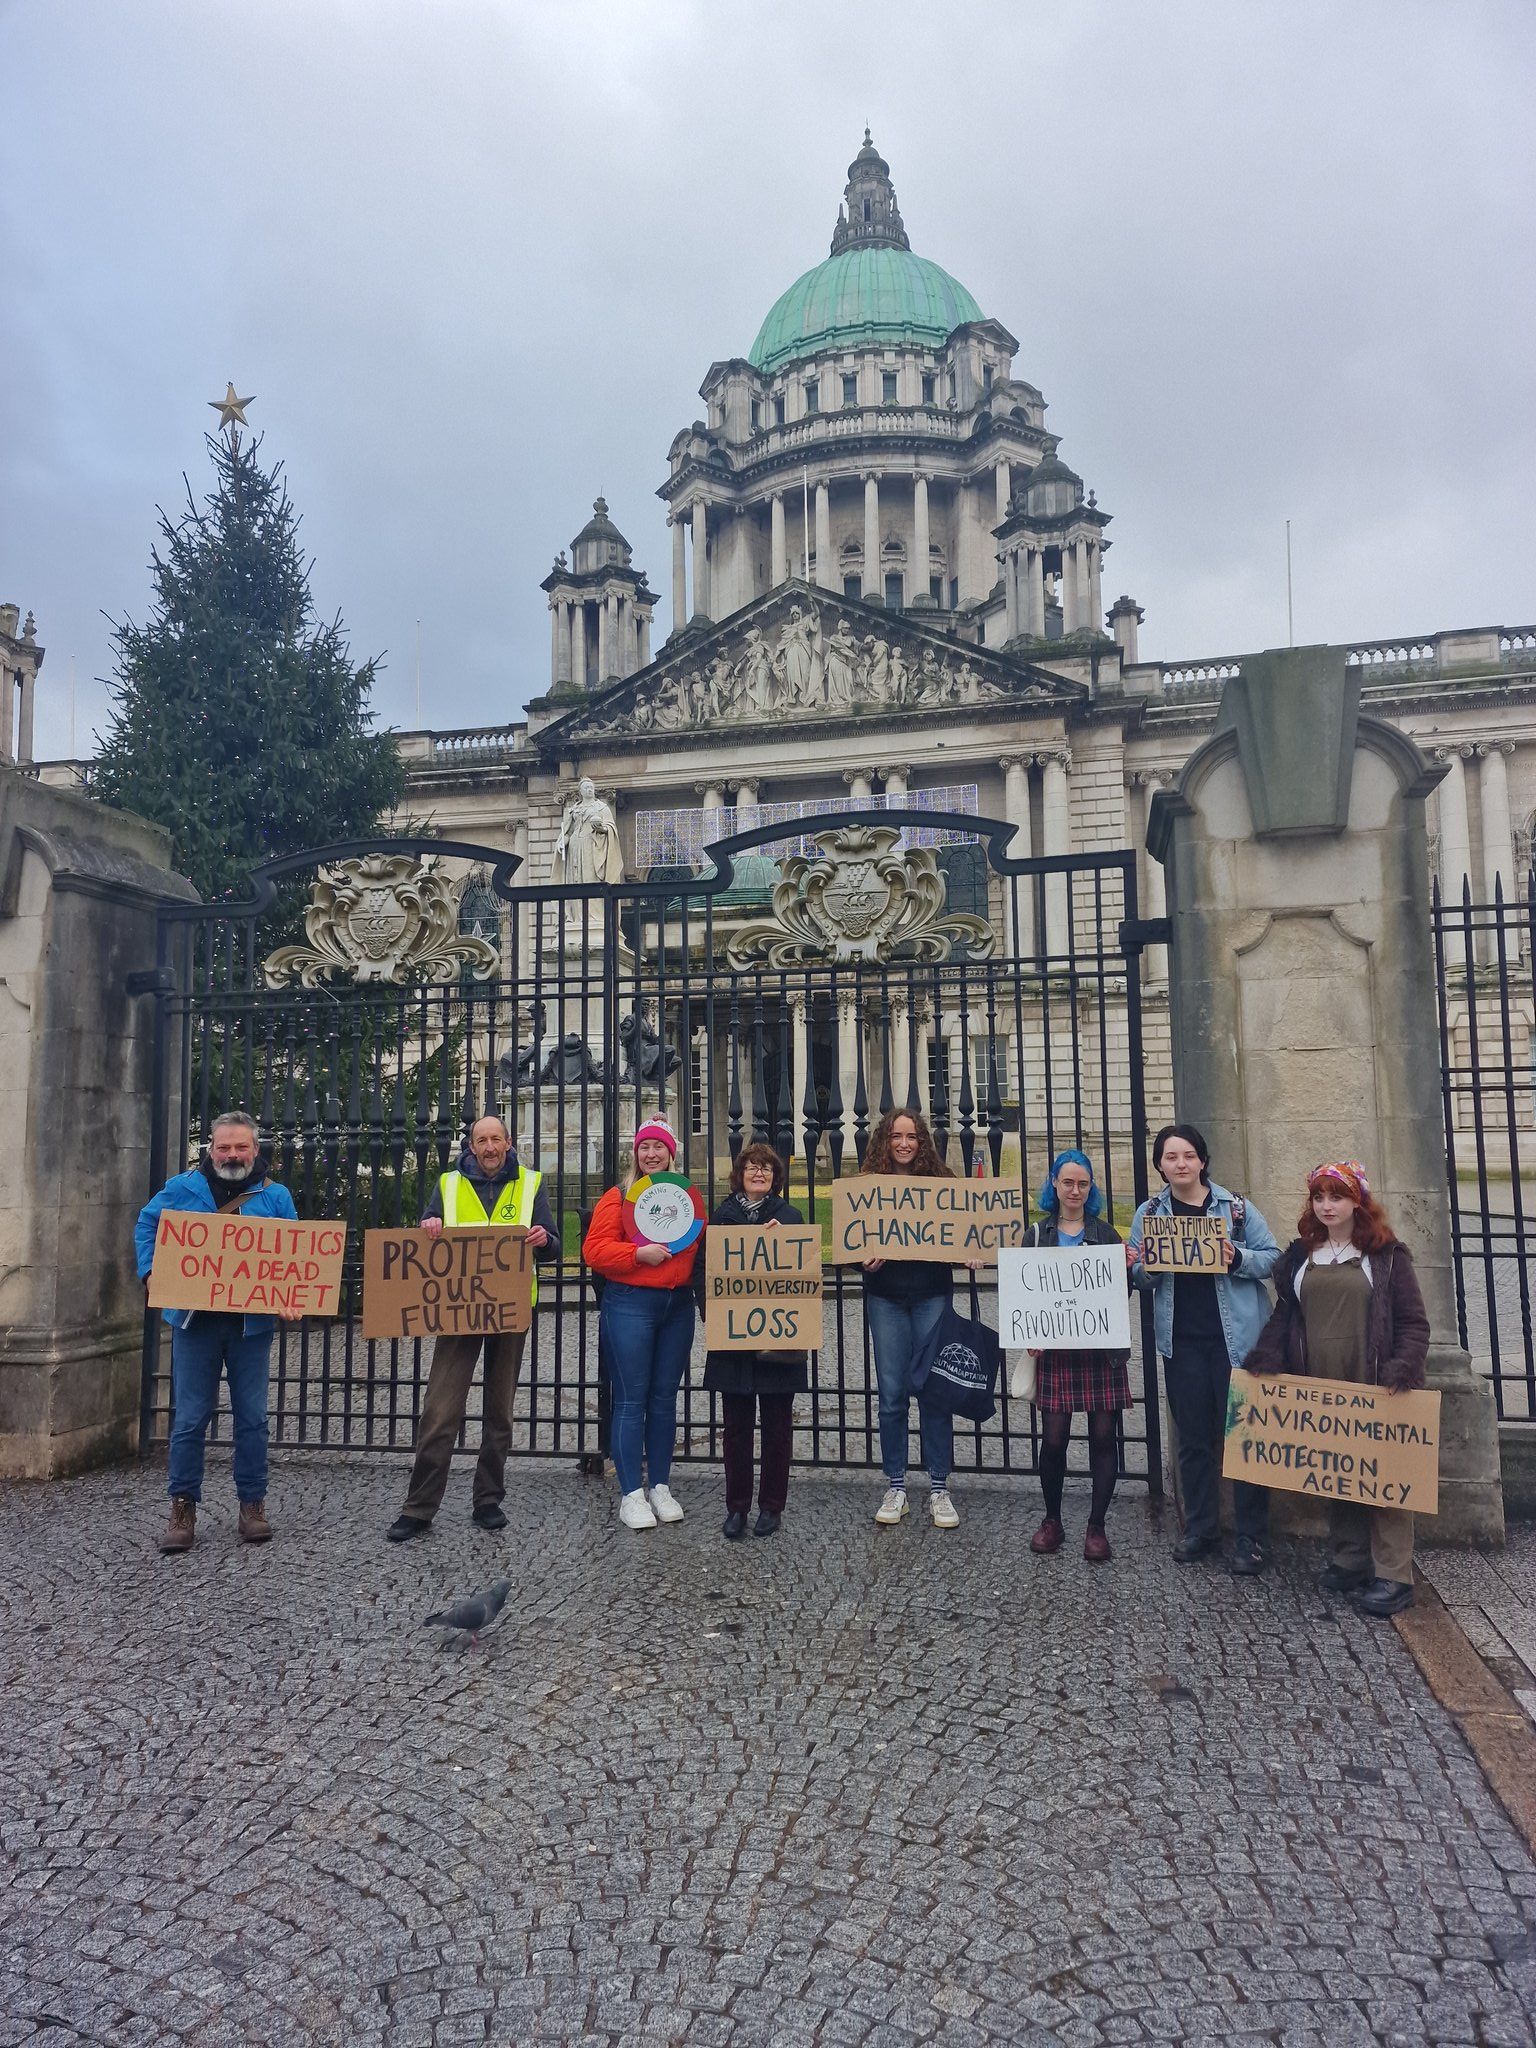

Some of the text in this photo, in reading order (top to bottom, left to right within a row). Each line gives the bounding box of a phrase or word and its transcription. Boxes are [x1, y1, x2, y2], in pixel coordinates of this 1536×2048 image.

[639, 1186, 690, 1218] FARMING CARBON
[847, 1186, 1022, 1212] WHAT CLIMATE
[161, 1219, 343, 1256] NO POLITICS
[844, 1218, 1022, 1251] CHANGE ACT?
[1142, 1216, 1178, 1236] FRIDAYS
[181, 1254, 320, 1281] ON A DEAD
[383, 1235, 528, 1281] PROTECT
[724, 1236, 813, 1271] HALT
[1143, 1236, 1227, 1267] BELFAST
[422, 1275, 497, 1304] OUR
[714, 1277, 820, 1297] BIODIVERSITY
[1021, 1258, 1112, 1293] CHILDREN
[210, 1282, 333, 1308] PLANET
[1054, 1298, 1077, 1309] OF THE
[401, 1302, 517, 1337] FUTURE
[728, 1307, 799, 1339] LOSS
[1012, 1307, 1109, 1341] REVOLUTION
[1262, 1384, 1375, 1409] WE NEED AN
[1233, 1404, 1433, 1446] ENVIRONMENTAL
[1242, 1440, 1378, 1477] PROTECTION
[1303, 1472, 1411, 1504] AGENCY
